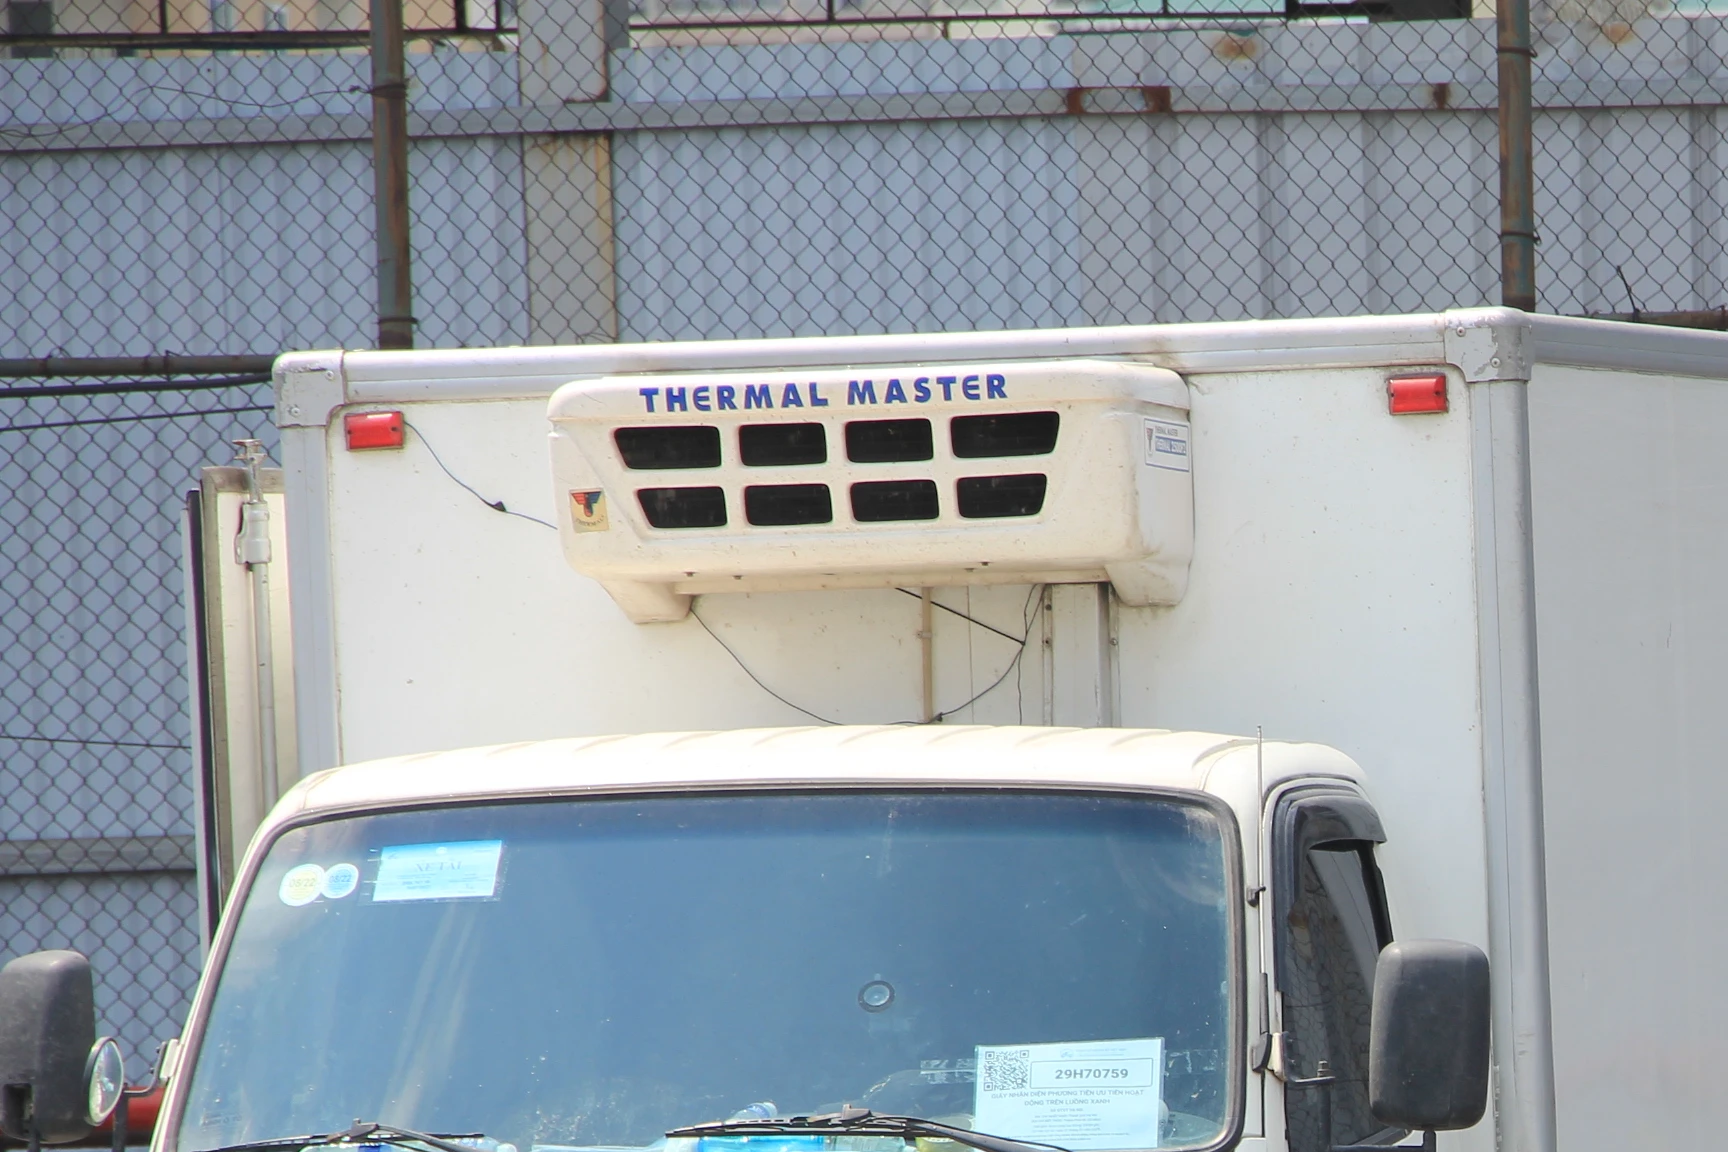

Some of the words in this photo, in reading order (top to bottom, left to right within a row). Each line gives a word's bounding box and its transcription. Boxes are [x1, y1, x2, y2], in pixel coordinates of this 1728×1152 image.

[639, 381, 829, 413] THERMAL
[847, 373, 1008, 406] MASTER
[1054, 1068, 1129, 1080] 29H70759
